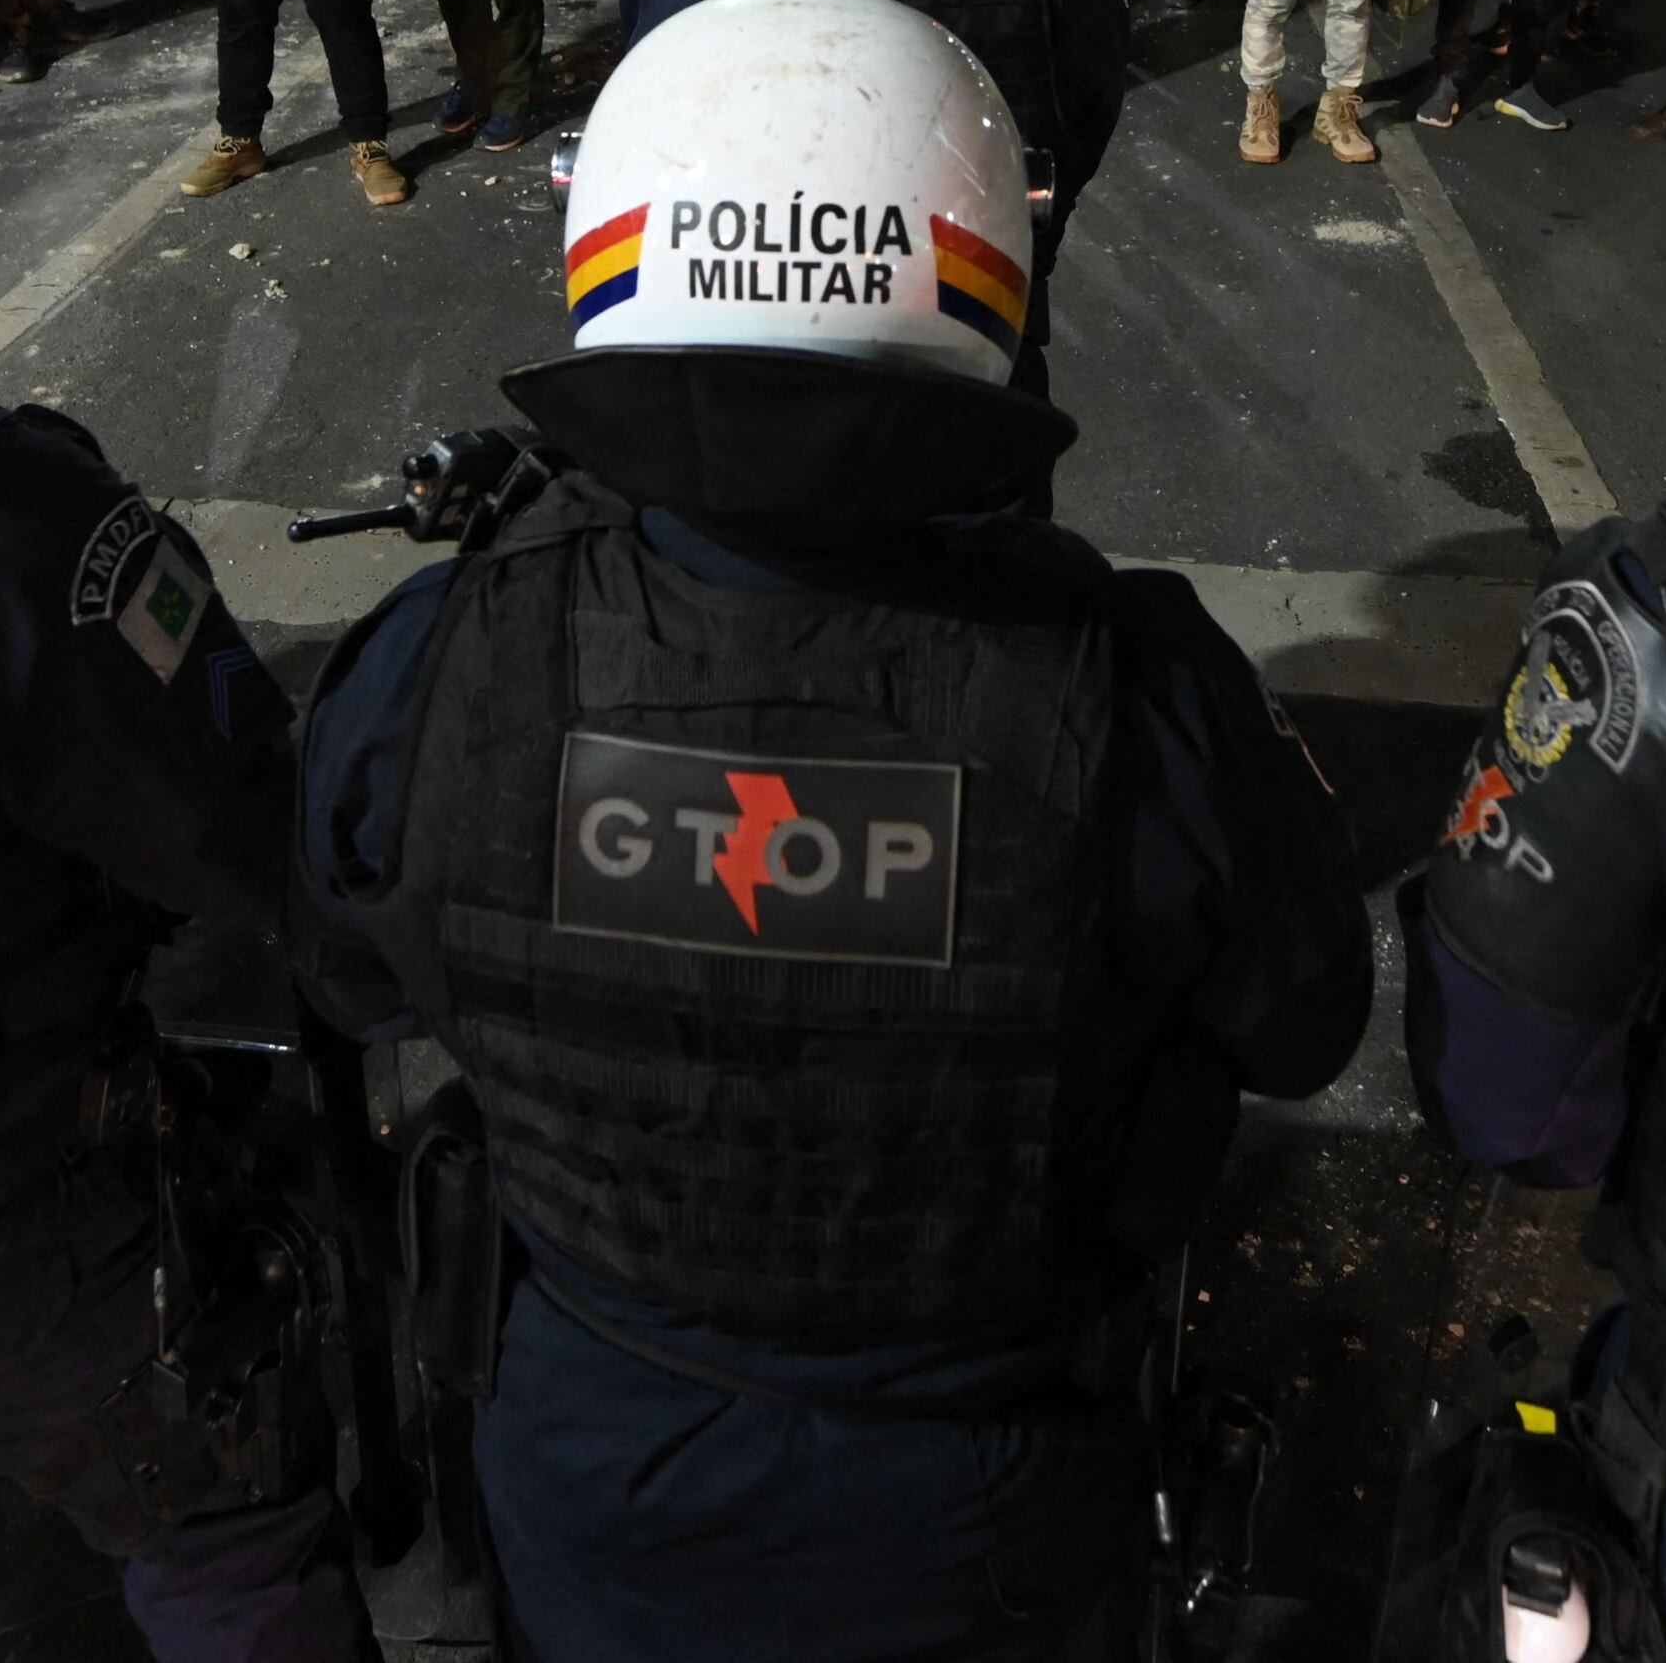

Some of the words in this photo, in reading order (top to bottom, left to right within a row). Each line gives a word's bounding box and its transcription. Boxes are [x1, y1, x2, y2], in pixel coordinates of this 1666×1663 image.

[671, 191, 913, 257] POLÍCIA
[687, 258, 893, 305] MILITAR
[79, 505, 143, 604] PMDF
[579, 797, 935, 899] GTOP
